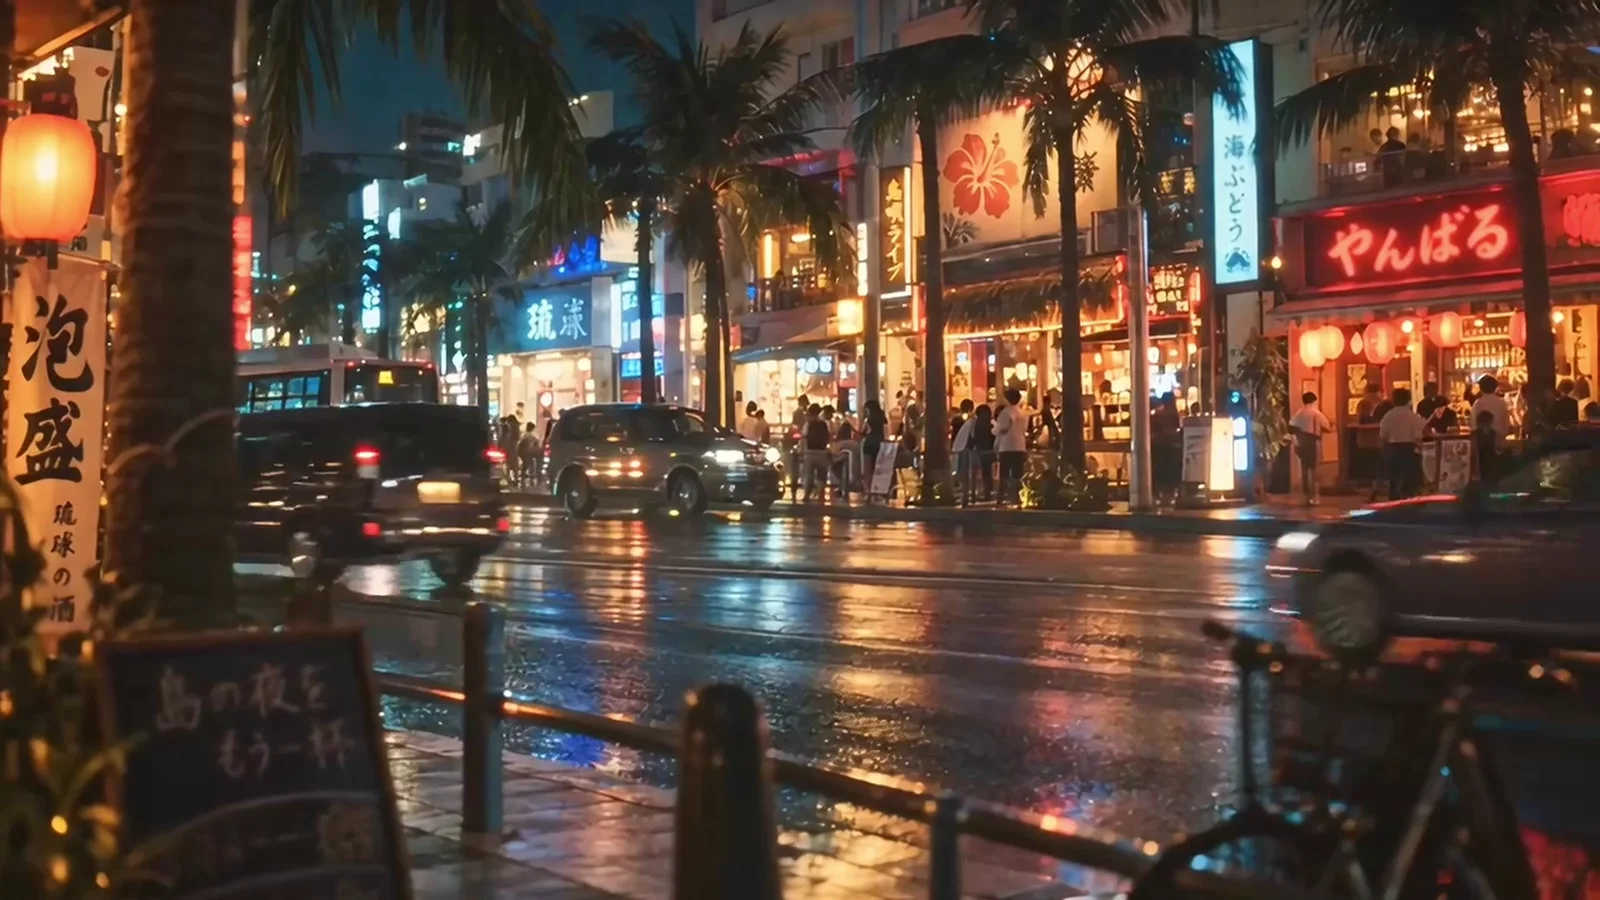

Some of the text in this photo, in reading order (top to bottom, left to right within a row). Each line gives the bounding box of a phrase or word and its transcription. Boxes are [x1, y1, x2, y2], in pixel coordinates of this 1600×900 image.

[1224, 134, 1246, 243] 海ぶどう
[1328, 204, 1509, 277] やんばる
[14, 293, 94, 486] 泡盛
